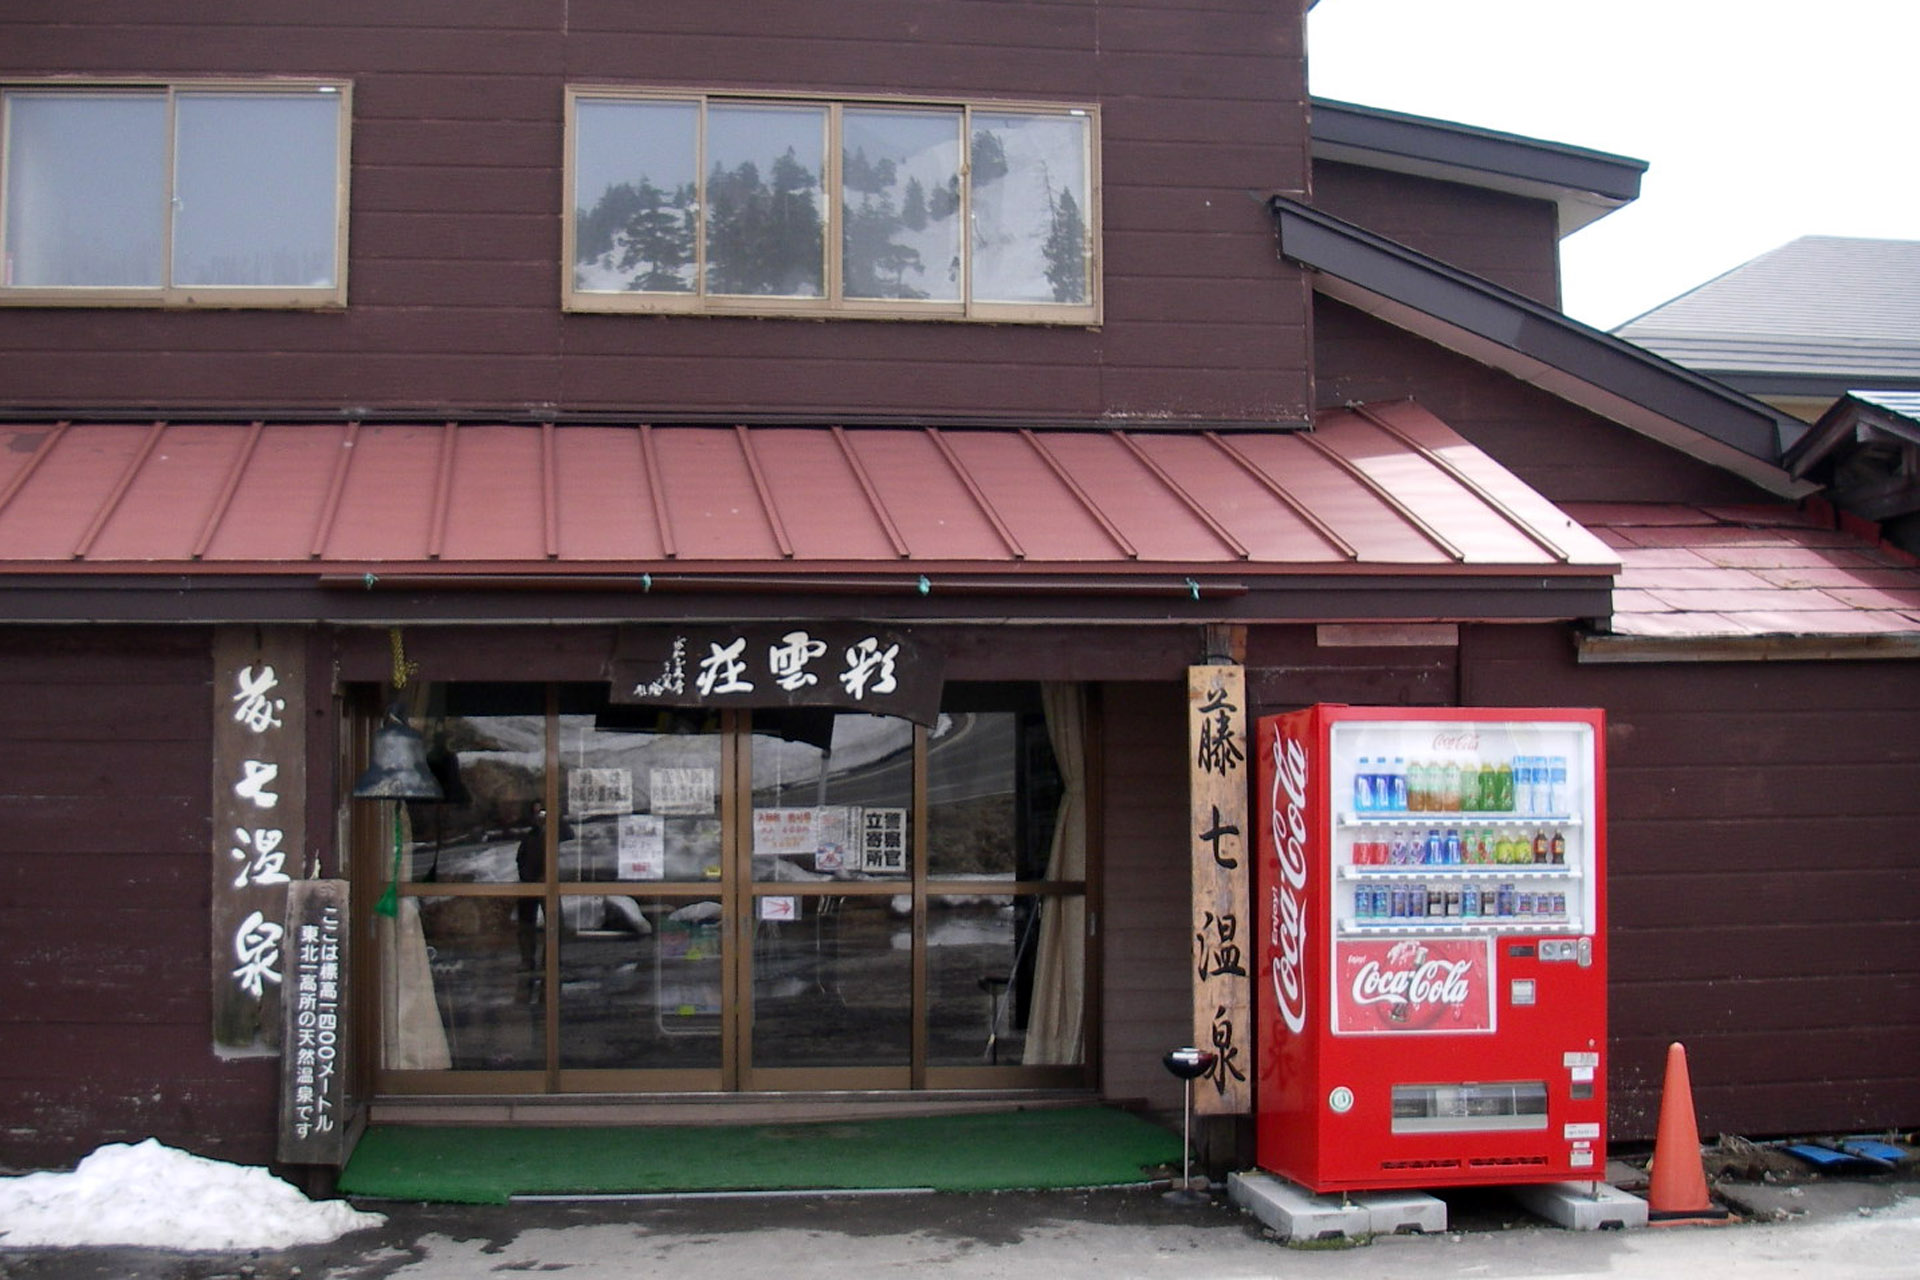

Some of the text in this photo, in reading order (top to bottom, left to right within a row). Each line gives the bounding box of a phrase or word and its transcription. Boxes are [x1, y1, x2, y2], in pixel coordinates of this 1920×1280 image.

[866, 812, 883, 867] 立寄所
[884, 812, 901, 867] 警察官
[1198, 688, 1247, 1096] 藤七温泉
[1272, 723, 1307, 1034] Coca-Cola
[296, 925, 320, 1140] 東北一高所の天然温泉です
[1352, 959, 1473, 1005] Coca-Cola
